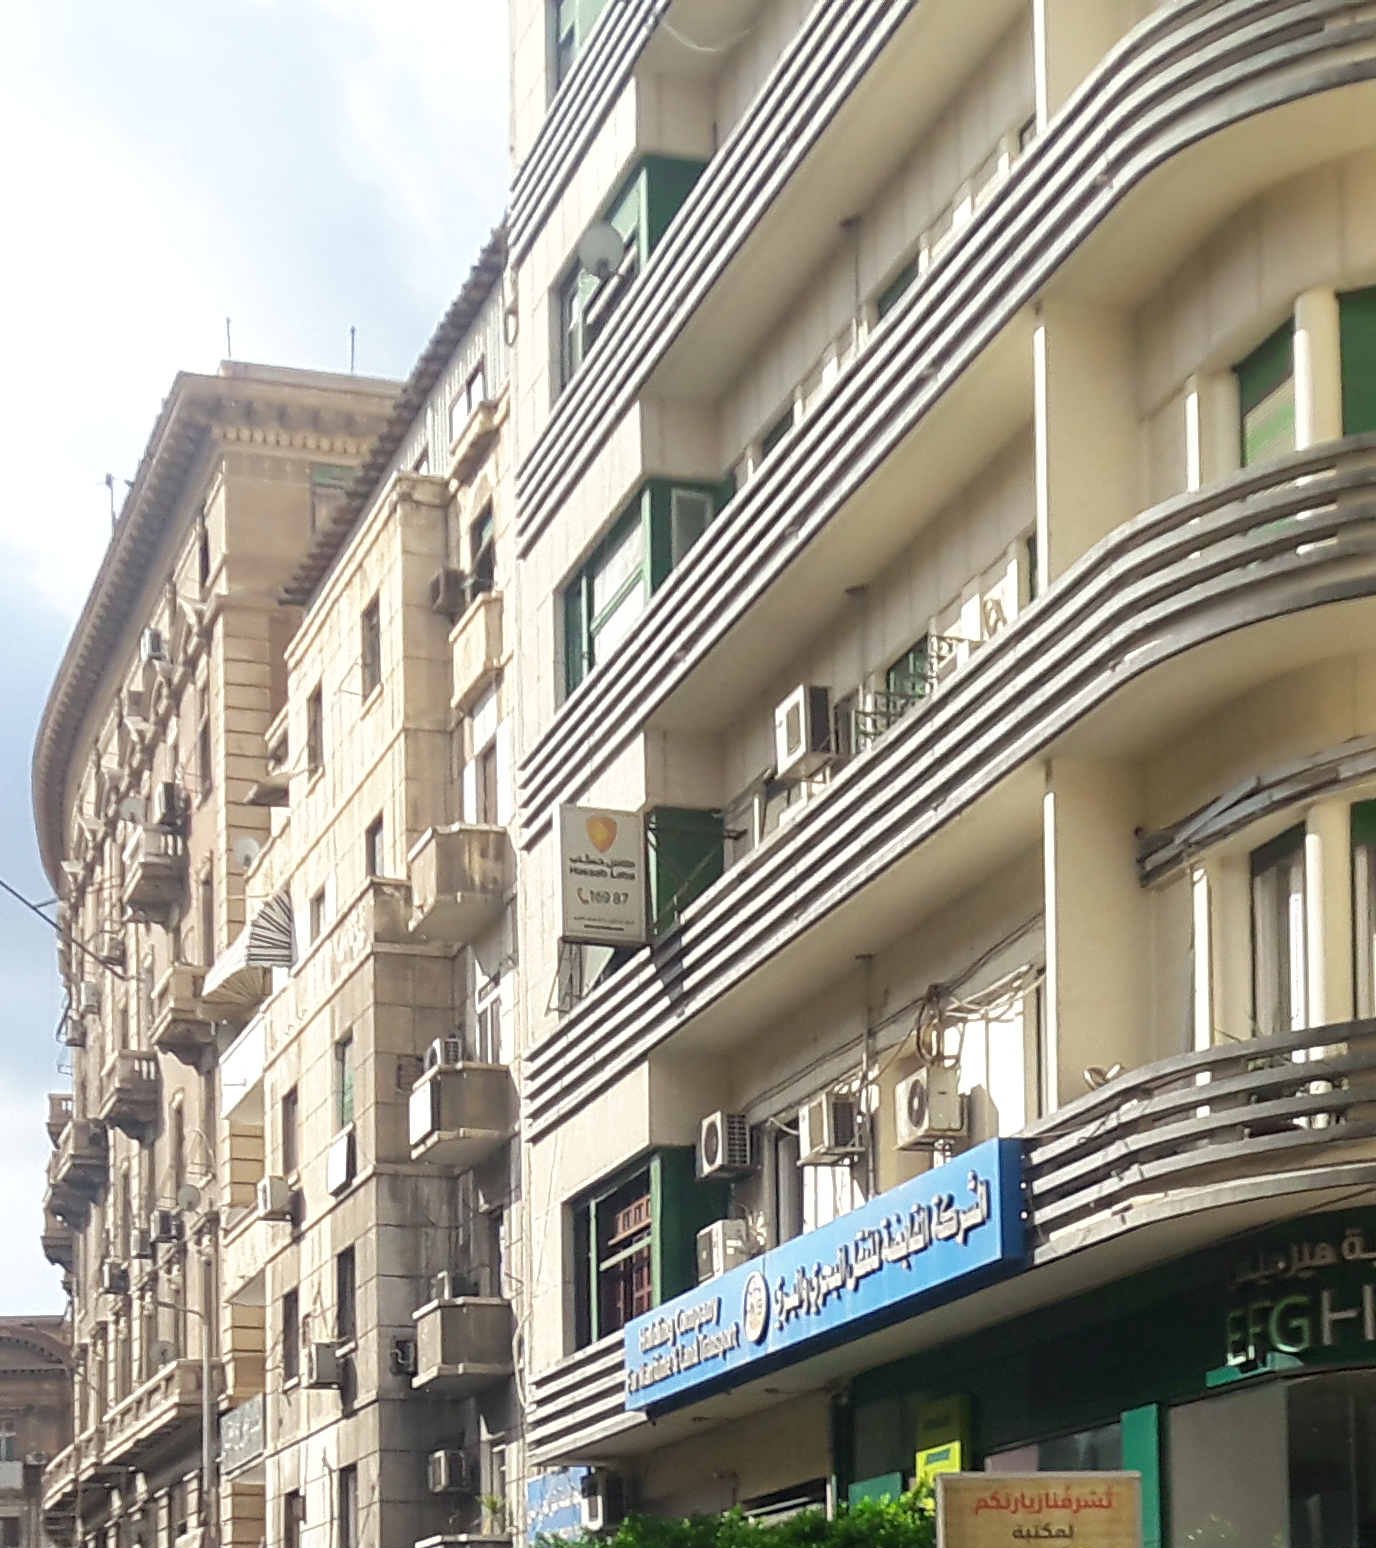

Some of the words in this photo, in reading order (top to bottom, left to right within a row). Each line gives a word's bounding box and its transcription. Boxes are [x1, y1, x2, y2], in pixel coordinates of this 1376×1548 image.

[1225, 1294, 1312, 1367] EFG
[974, 1490, 1044, 1517] زيارتكم
[1011, 1521, 1075, 1542] لمكتبة
